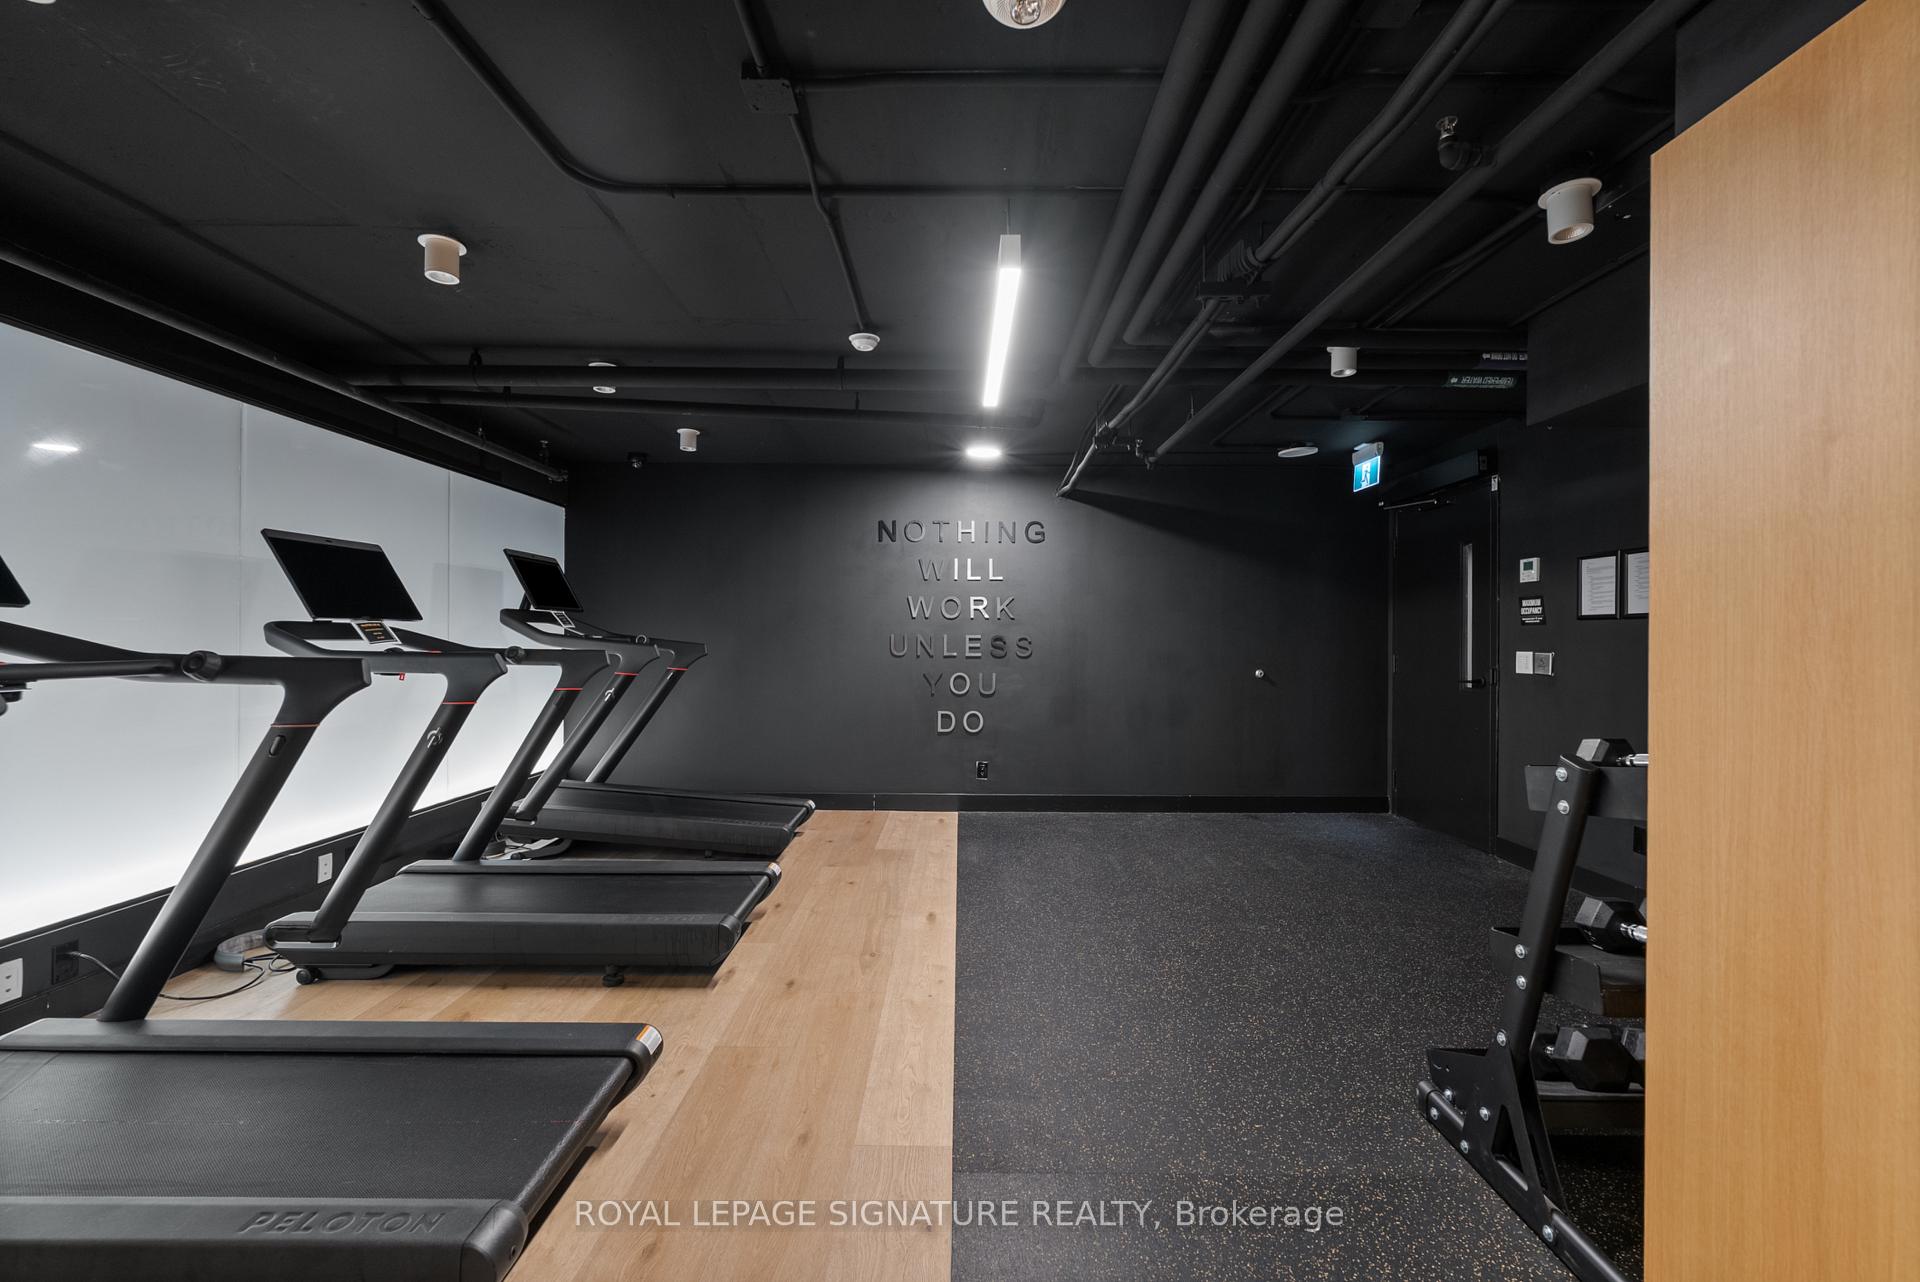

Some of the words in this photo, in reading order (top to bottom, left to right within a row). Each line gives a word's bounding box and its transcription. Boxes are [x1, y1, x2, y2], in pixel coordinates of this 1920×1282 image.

[877, 520, 1046, 544] NOTHING
[918, 558, 1004, 581] WILL
[907, 595, 1015, 620] WORK
[889, 633, 1033, 659] UNLESS
[922, 672, 997, 697] YOU
[936, 710, 984, 735] DO
[237, 1210, 446, 1234] PELOTON
